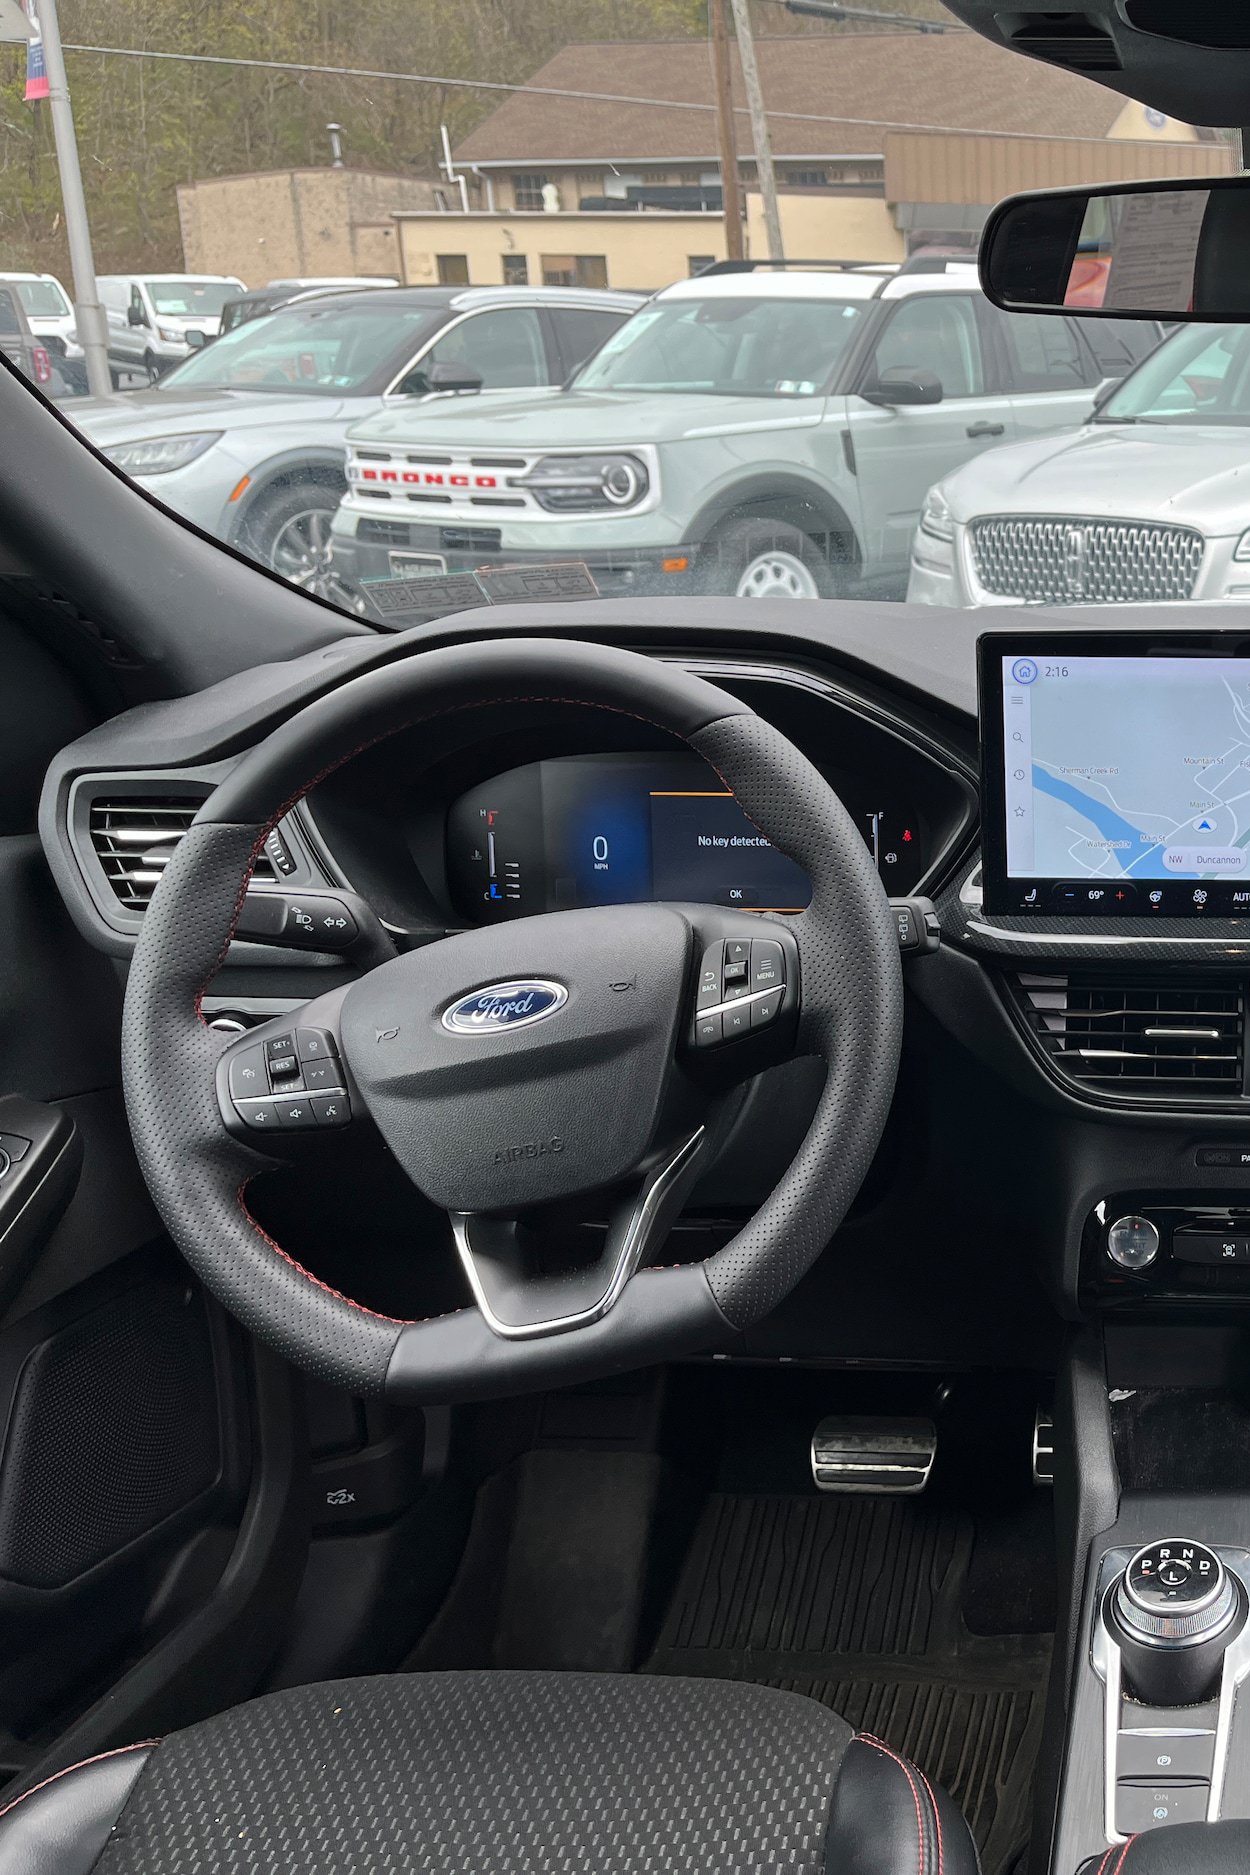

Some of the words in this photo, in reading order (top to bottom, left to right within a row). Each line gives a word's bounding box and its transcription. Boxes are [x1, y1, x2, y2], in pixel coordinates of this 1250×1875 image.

[362, 469, 496, 487] BRONCO
[1045, 667, 1069, 677] 2:16
[1060, 766, 1088, 774] Sherman
[480, 809, 487, 817] H
[698, 836, 711, 846] No
[713, 836, 729, 848] key
[593, 836, 608, 861] 0
[1169, 856, 1183, 864] NW
[1197, 856, 1241, 864] Duncannon
[730, 890, 743, 898] OK
[1088, 890, 1104, 900] 69°
[756, 971, 775, 980] MENU
[702, 983, 718, 993] BACK
[472, 993, 535, 1023] Ford
[275, 1061, 290, 1070] RES
[494, 1136, 564, 1165] AIRBAG
[1141, 1559, 1152, 1569] P
[1160, 1548, 1170, 1558] R
[1182, 1548, 1193, 1558] N
[1200, 1560, 1210, 1570] D
[1169, 1571, 1178, 1581] L
[1153, 1793, 1169, 1801] ON
